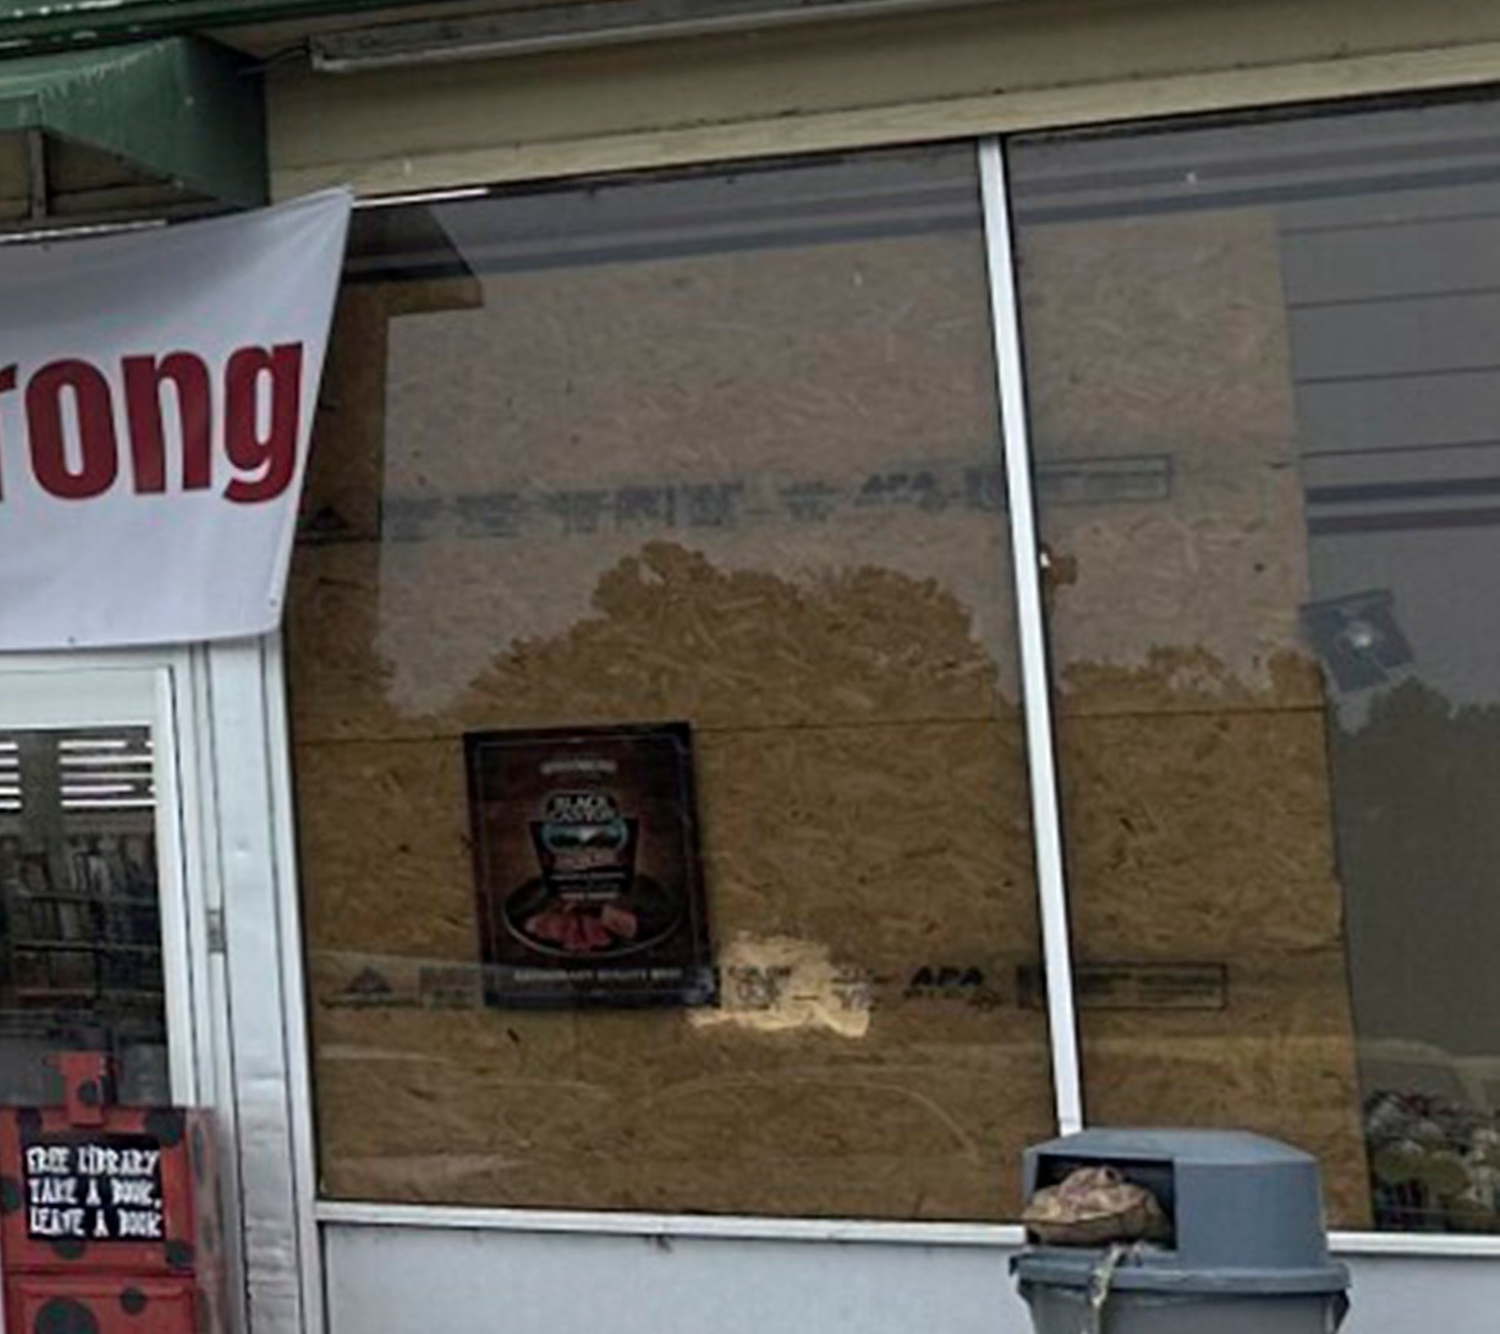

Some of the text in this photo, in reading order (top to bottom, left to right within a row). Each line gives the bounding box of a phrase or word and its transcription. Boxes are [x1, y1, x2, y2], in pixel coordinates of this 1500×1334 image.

[908, 966, 984, 986] APA
[26, 1143, 160, 1177] FREE LIBRARY
[27, 1177, 79, 1205] TAKE
[85, 1178, 103, 1206] A
[29, 1206, 87, 1236] LEAVE
[93, 1208, 110, 1237] A
